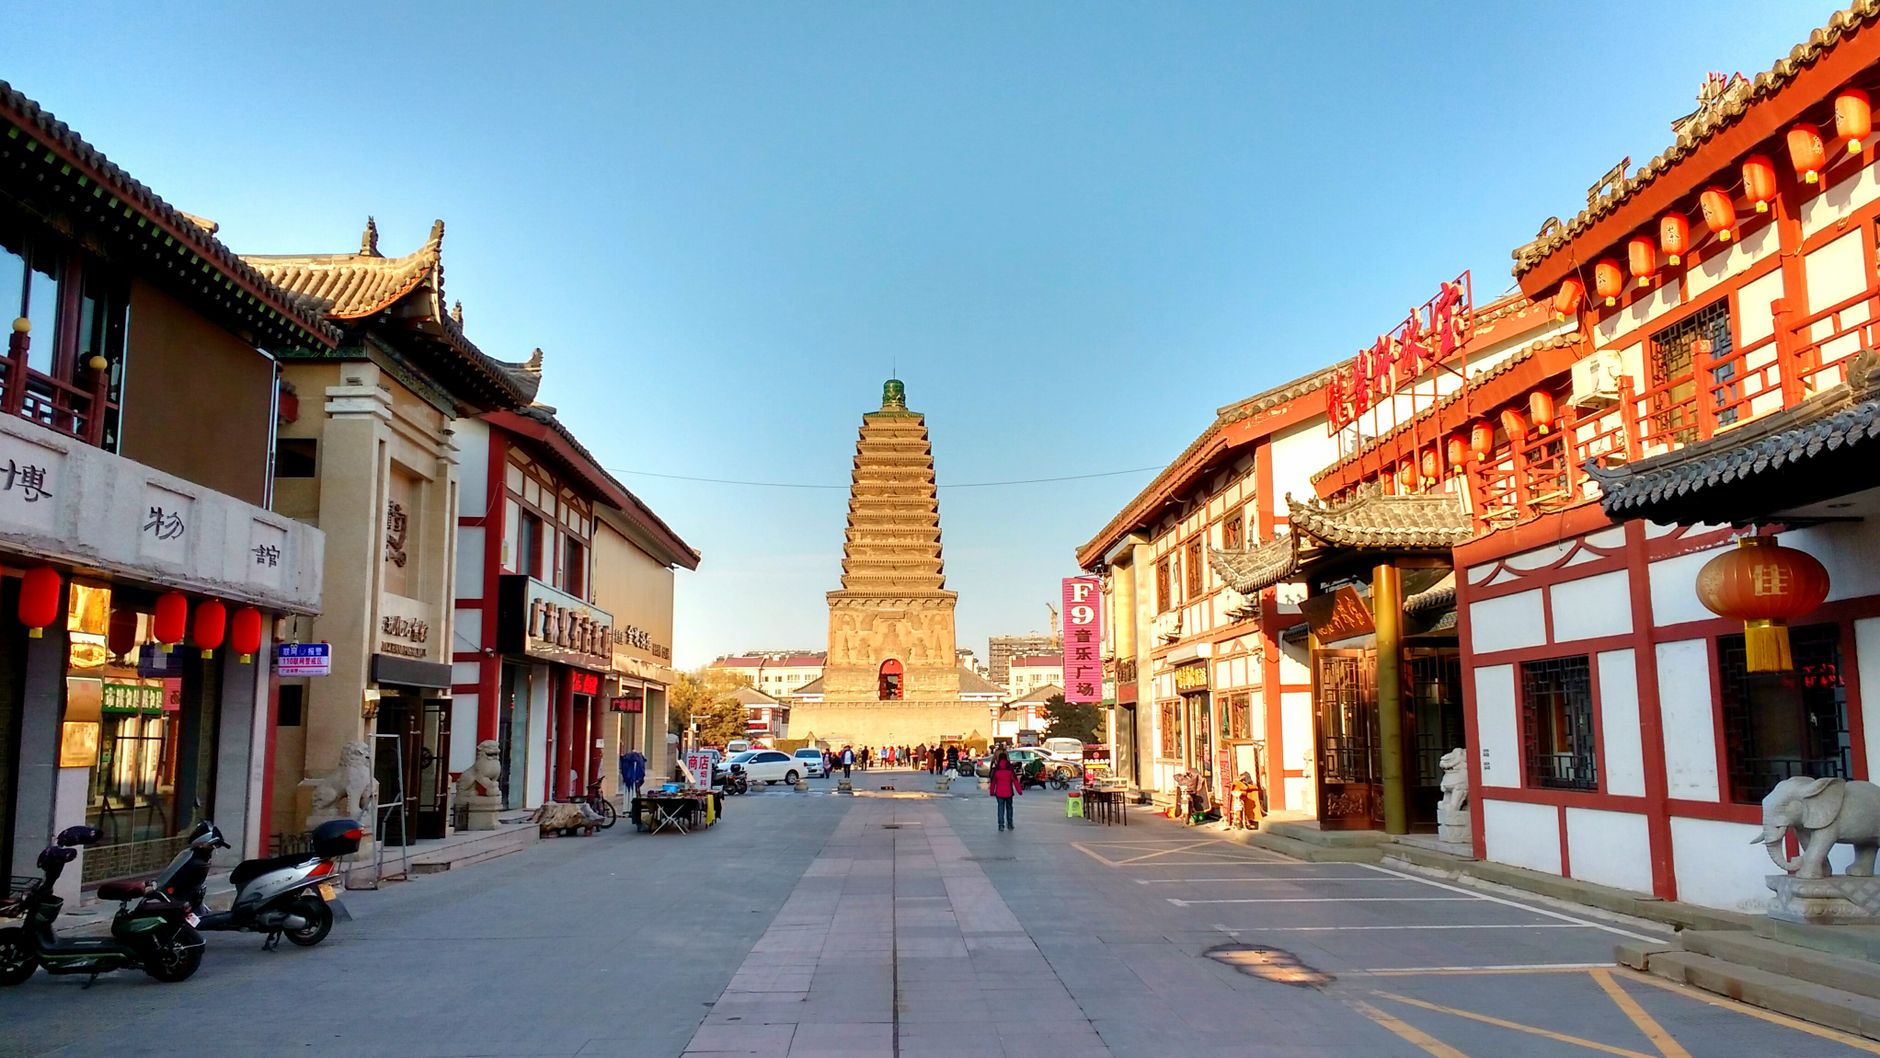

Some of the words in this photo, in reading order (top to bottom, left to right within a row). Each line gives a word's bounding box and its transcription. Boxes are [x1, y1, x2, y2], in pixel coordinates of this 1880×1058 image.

[1074, 628, 1094, 696] 音乐广场
[688, 754, 710, 771] 商店
